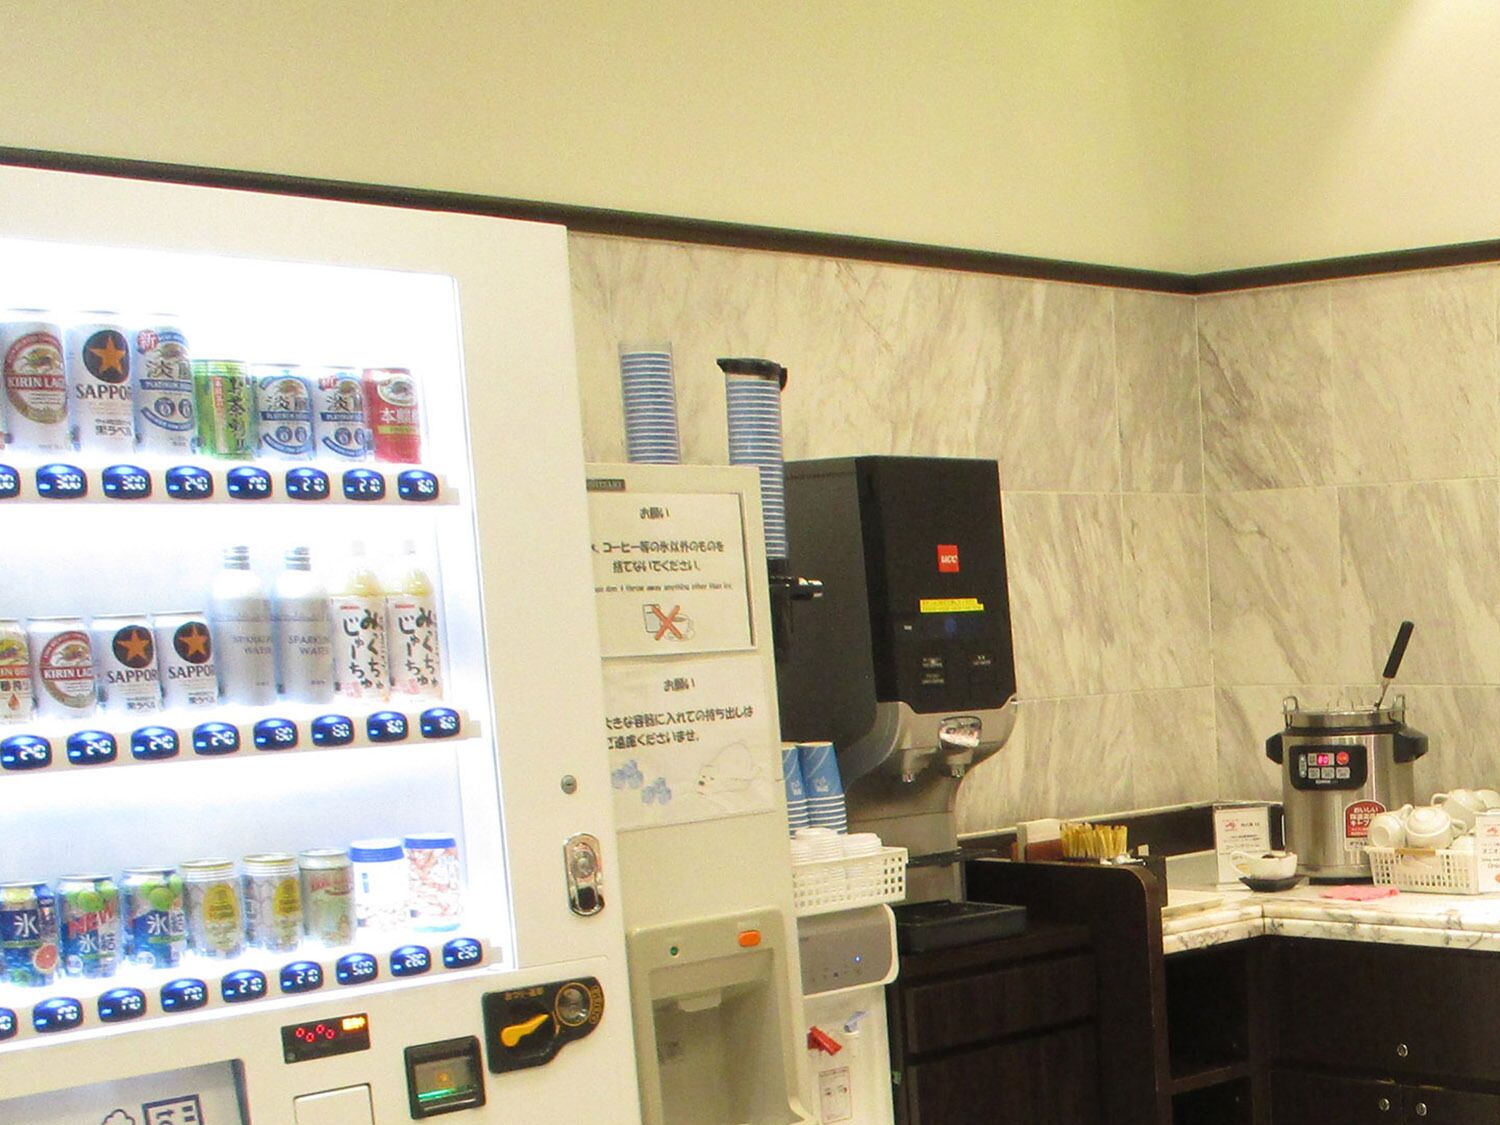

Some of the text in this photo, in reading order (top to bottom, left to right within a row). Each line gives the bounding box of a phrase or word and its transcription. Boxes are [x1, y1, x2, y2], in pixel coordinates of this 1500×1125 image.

[640, 506, 670, 519] お願い
[664, 678, 696, 691] お願い
